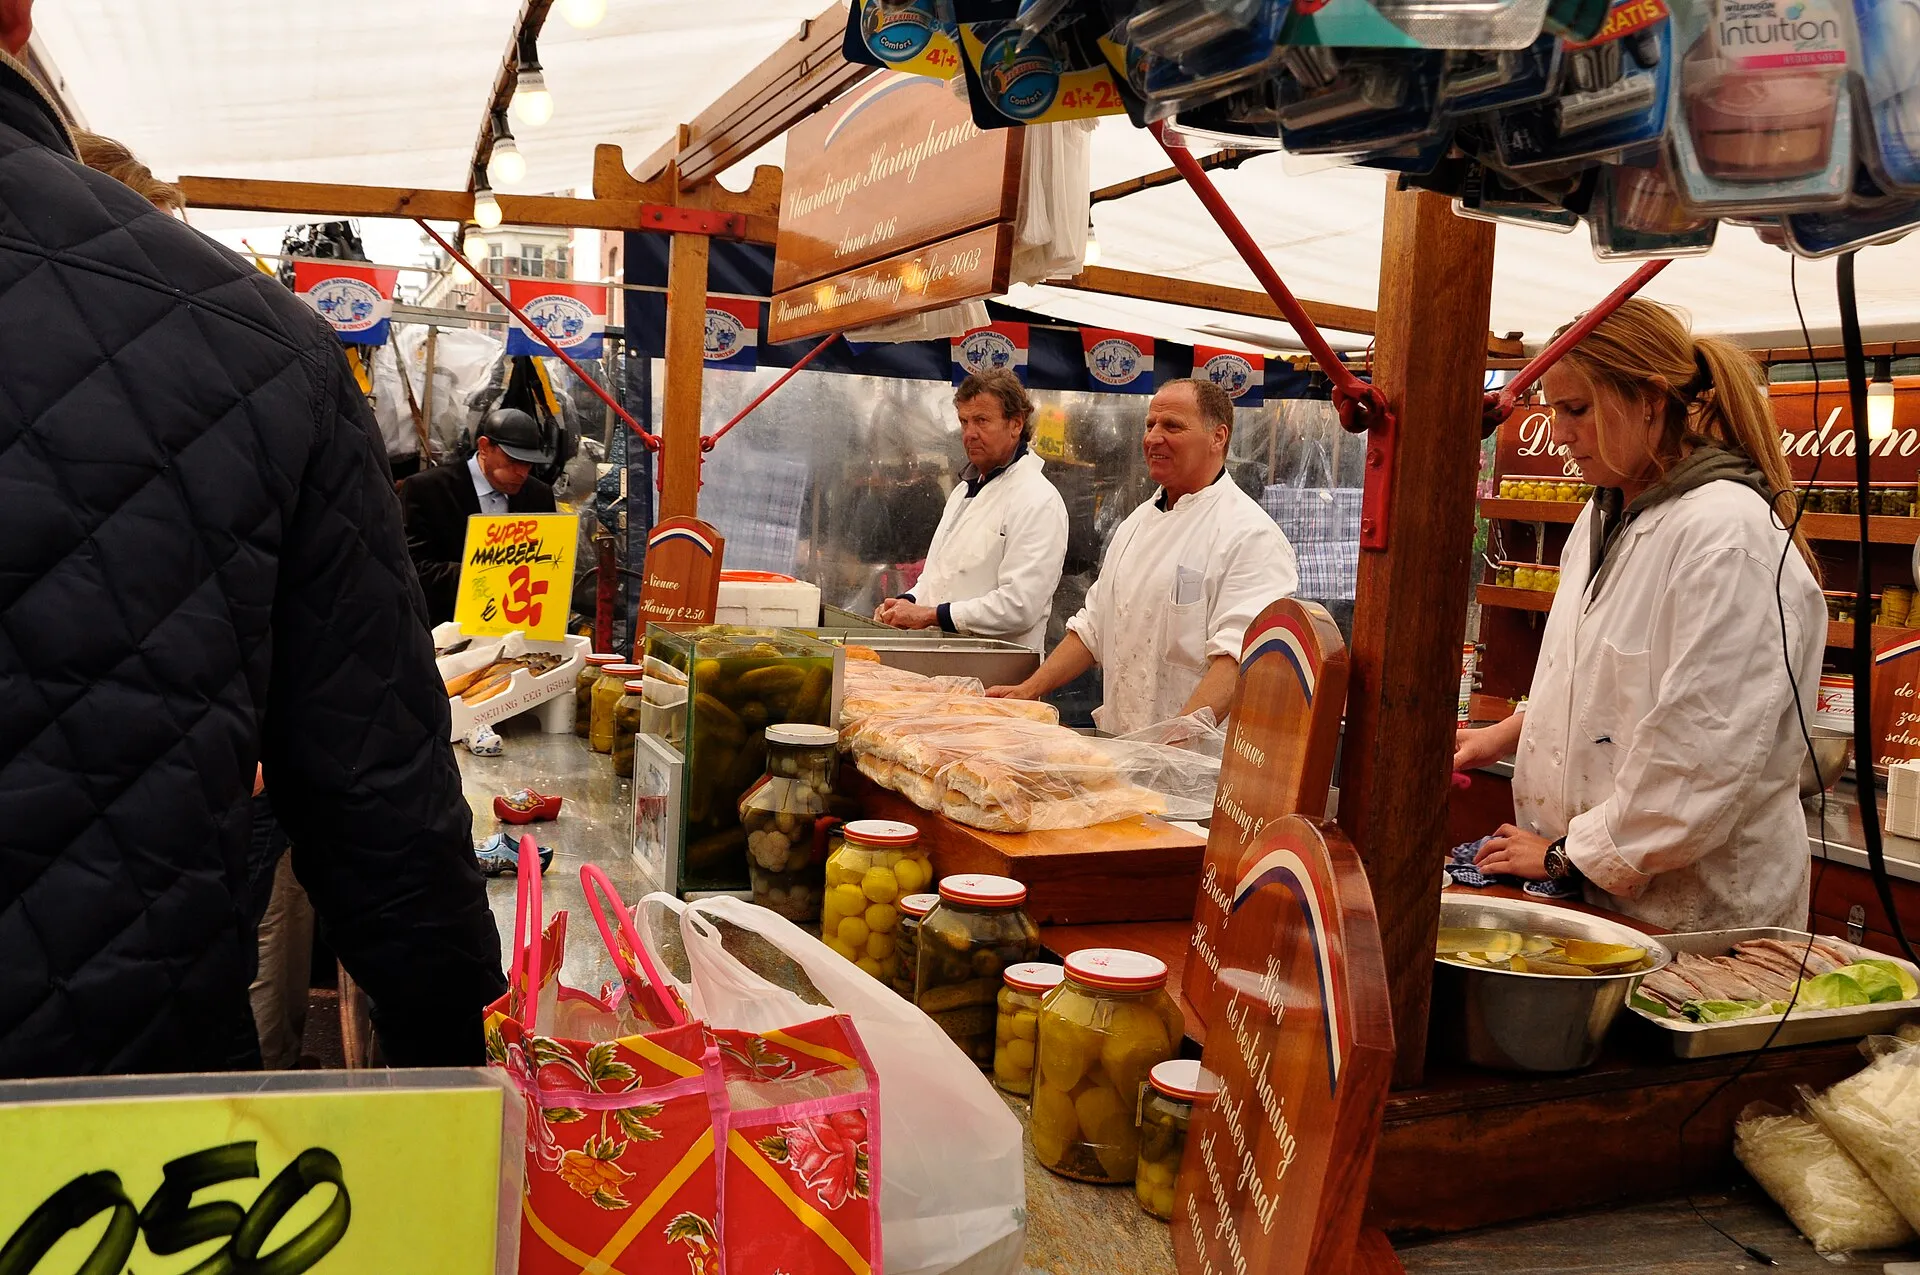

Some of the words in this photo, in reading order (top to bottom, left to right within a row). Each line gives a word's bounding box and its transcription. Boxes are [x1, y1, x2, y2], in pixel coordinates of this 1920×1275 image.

[1599, 0, 1661, 37] RATIS
[1719, 18, 1838, 47] Intuition
[880, 36, 912, 50] Comfort
[1009, 90, 1042, 105] Comfort
[862, 112, 986, 184] Haringhande
[834, 226, 867, 259] Anno
[869, 215, 898, 246] 1916
[862, 270, 904, 304] Haring
[905, 253, 946, 296] Trofee
[948, 247, 982, 276] 2003
[470, 537, 552, 567] MAKREEL
[484, 519, 538, 547] SUPER
[643, 572, 681, 591] Nieuwe
[641, 598, 676, 622] Haring
[677, 606, 685, 618] €
[1894, 682, 1917, 698] de
[1216, 783, 1254, 845] Haring
[1202, 862, 1234, 930] Brood
[1190, 921, 1220, 992] Harin
[1259, 954, 1287, 1026] Hier
[1226, 987, 1240, 1031] de
[1236, 1005, 1261, 1078] beste
[1256, 1051, 1298, 1181] haring
[1212, 1074, 1247, 1158] zonder
[1237, 1150, 1280, 1236] graat
[1200, 1128, 1248, 1275] schoongema
